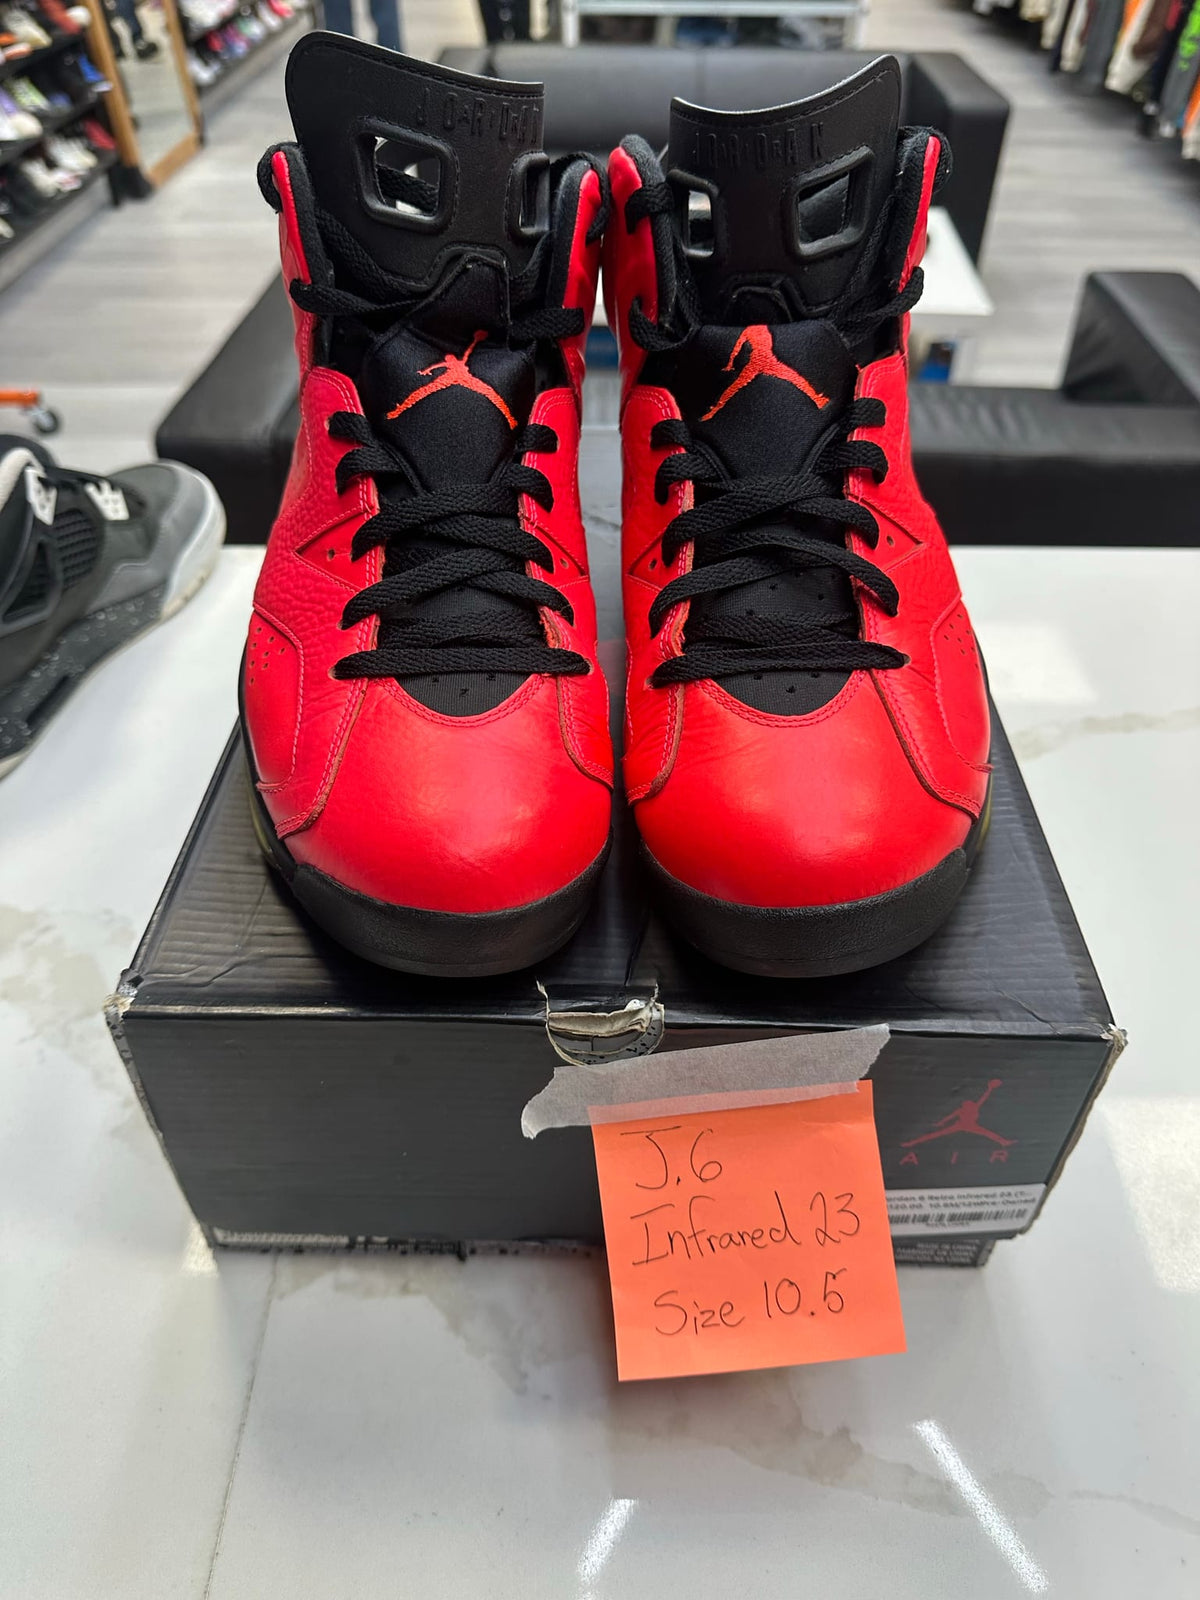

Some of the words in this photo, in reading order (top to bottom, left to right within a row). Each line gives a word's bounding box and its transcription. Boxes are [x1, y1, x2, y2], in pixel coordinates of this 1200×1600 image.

[620, 1125, 723, 1190] J.6
[899, 1150, 1009, 1166] AIR
[630, 1190, 802, 1266] Infrared
[809, 1191, 861, 1248] 23
[653, 1290, 746, 1336] Size
[763, 1268, 847, 1319] 10.5
